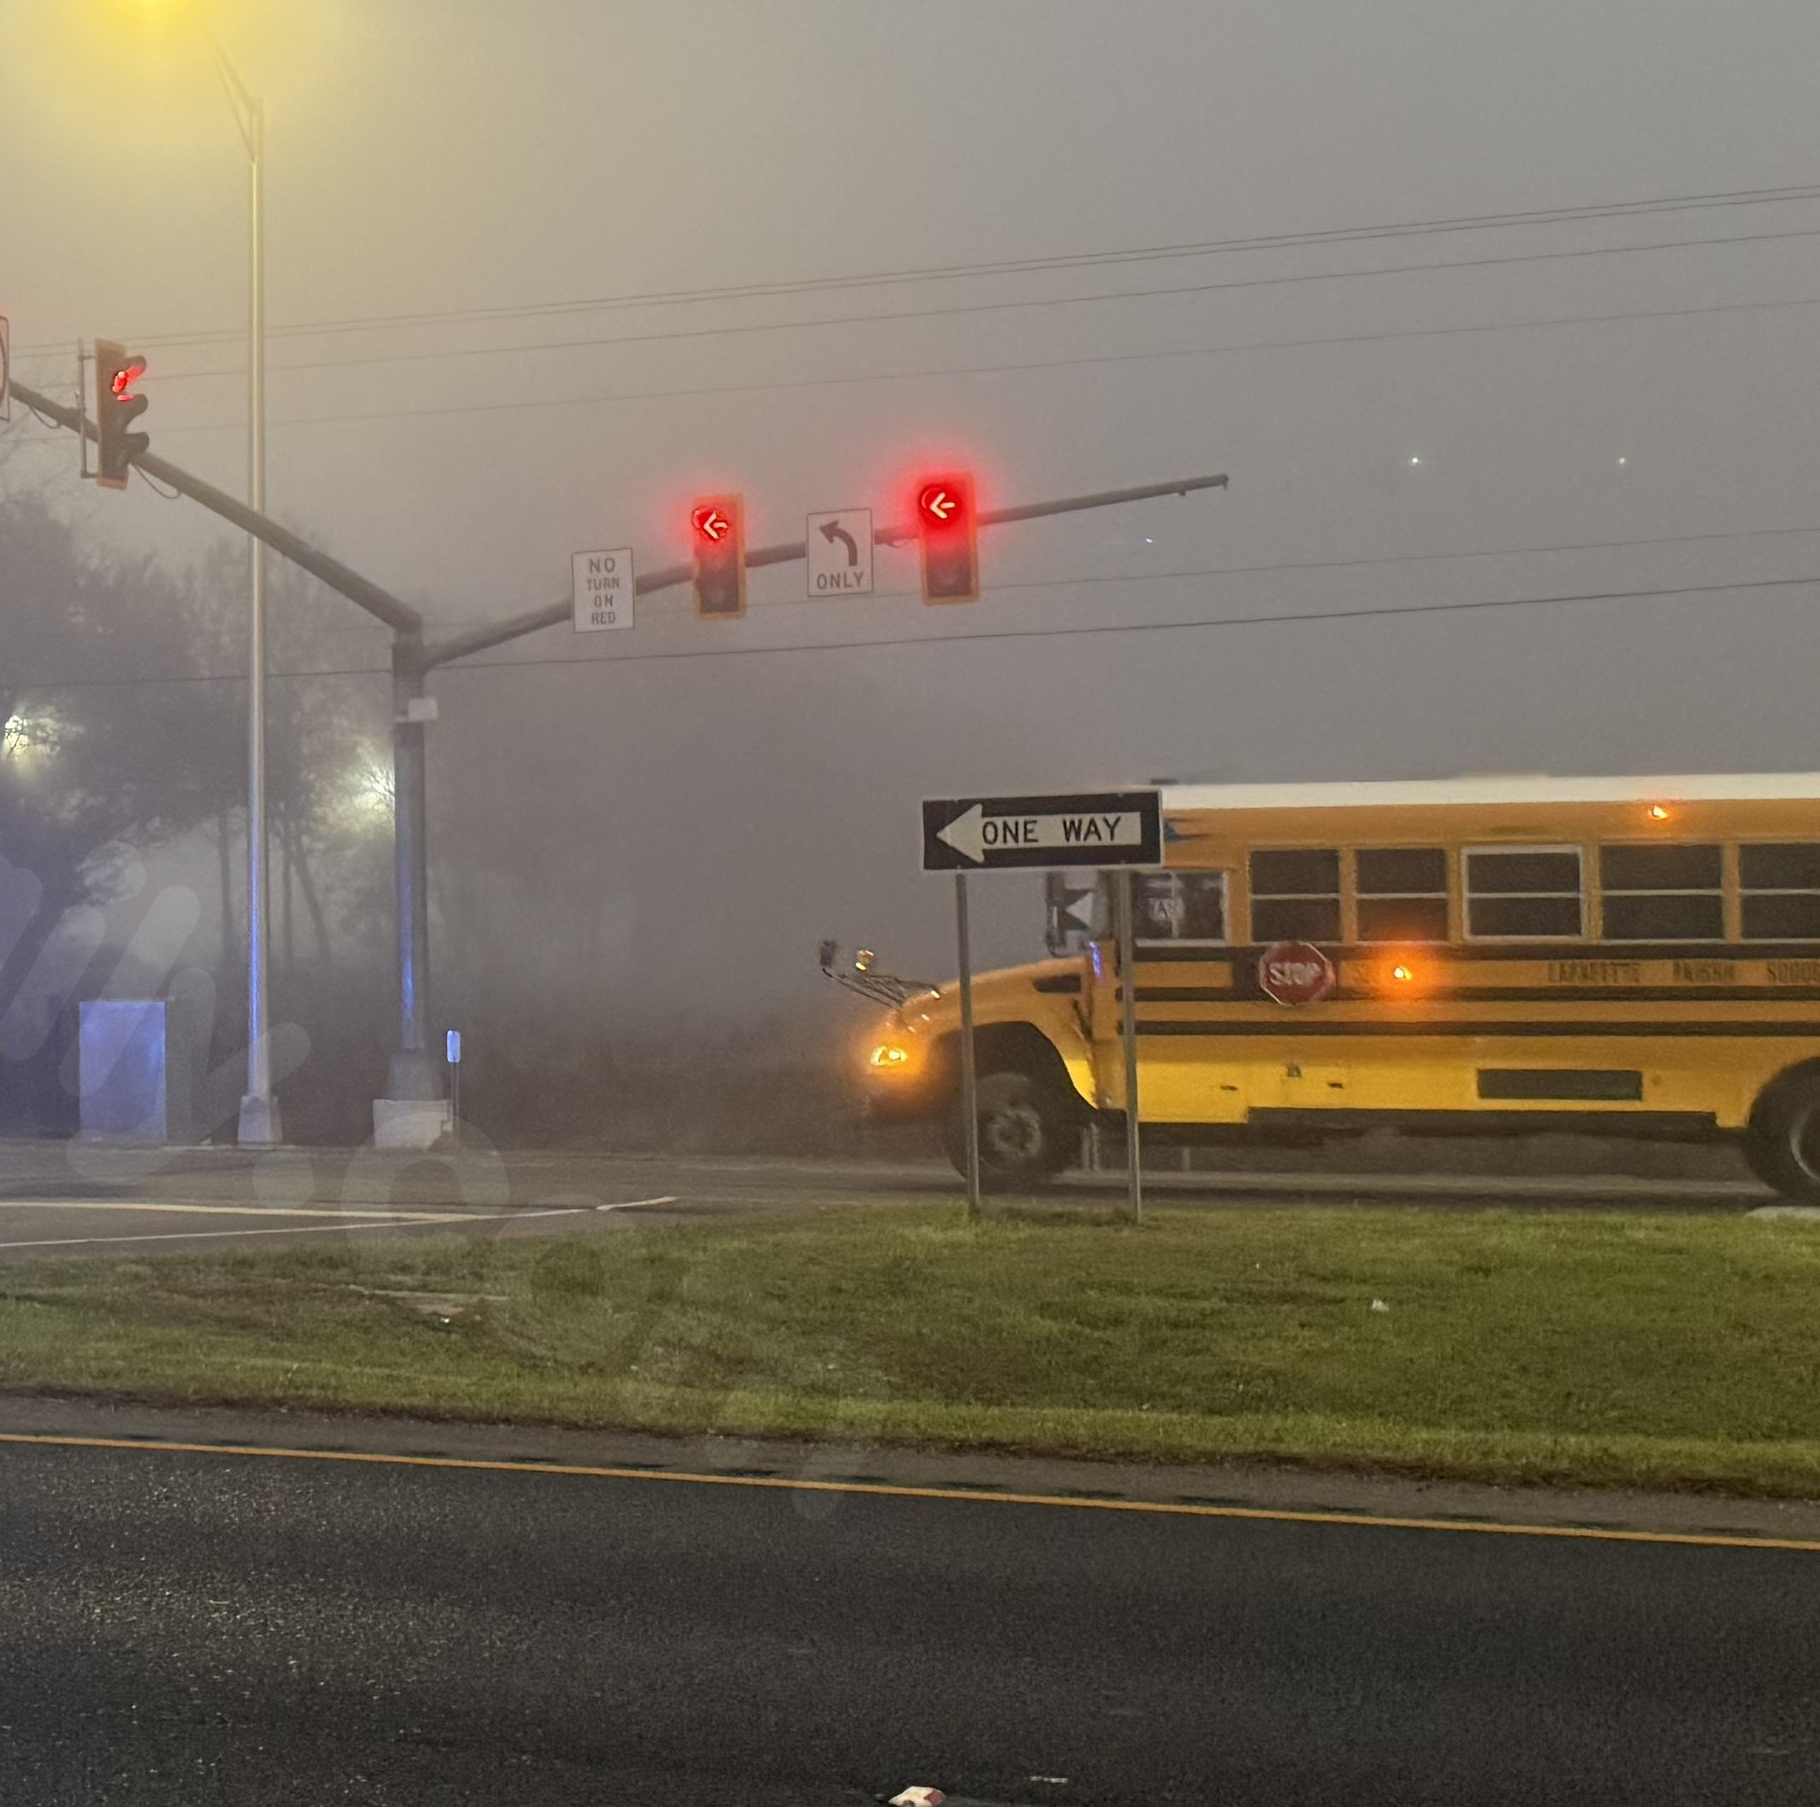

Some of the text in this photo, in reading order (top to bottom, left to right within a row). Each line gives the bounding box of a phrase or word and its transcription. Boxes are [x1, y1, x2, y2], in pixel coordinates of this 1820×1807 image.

[588, 558, 616, 574] NO
[587, 577, 620, 592] TURN
[817, 571, 865, 591] ONLY
[594, 595, 614, 608] ON
[591, 611, 616, 625] RED
[982, 816, 1122, 845] ONE WAY
